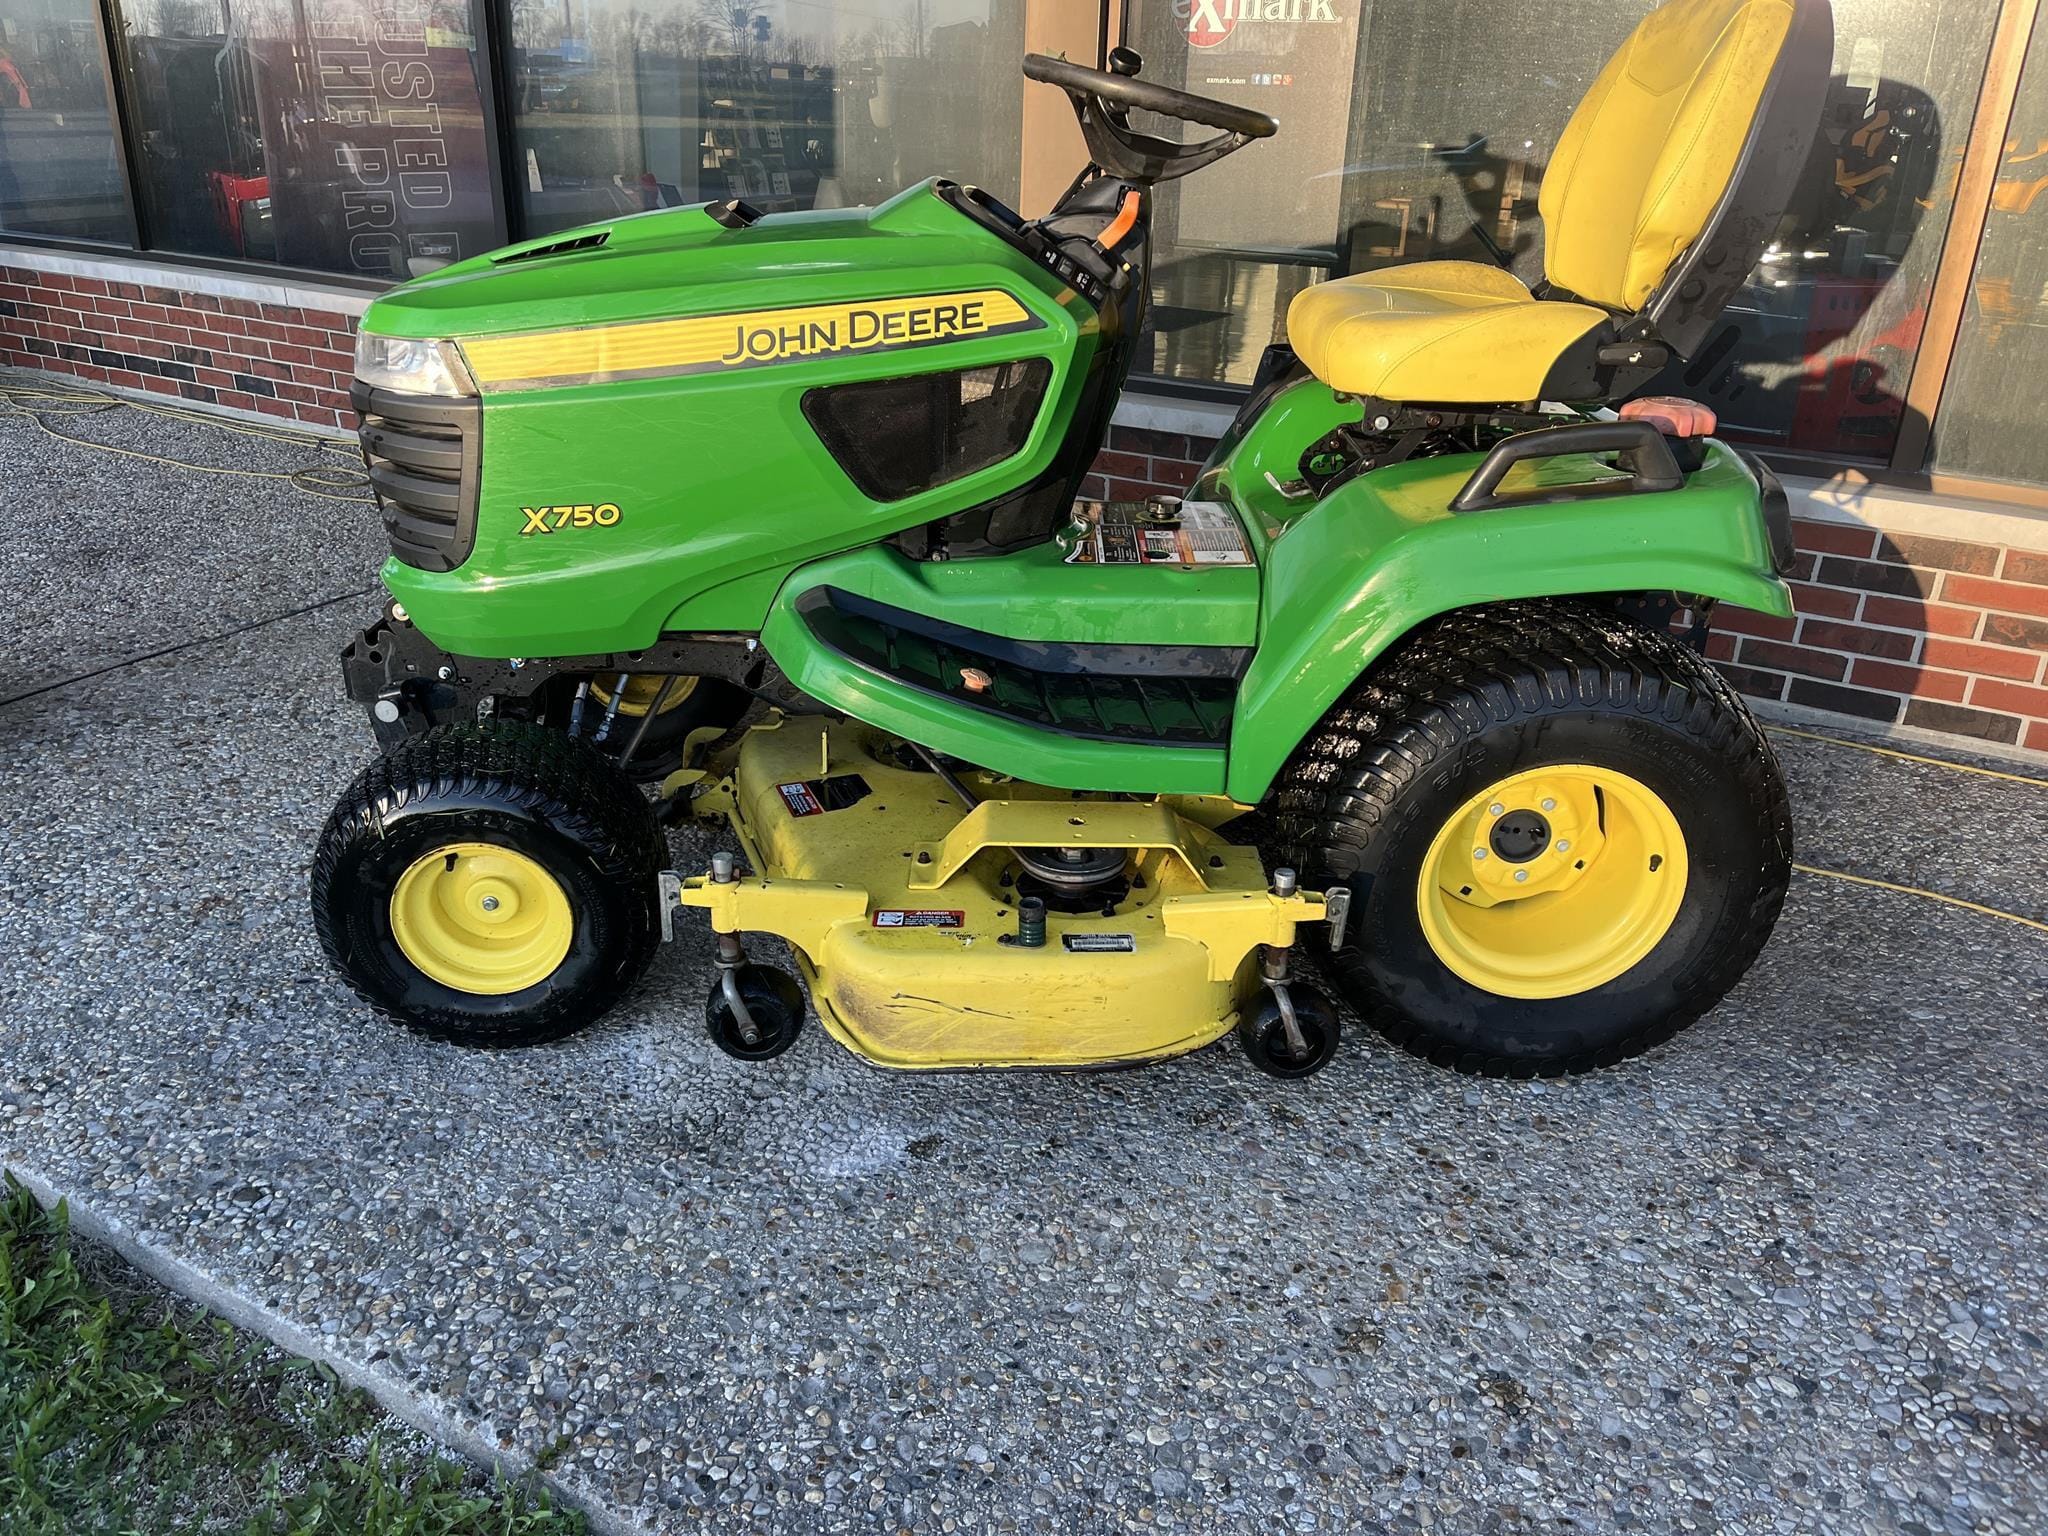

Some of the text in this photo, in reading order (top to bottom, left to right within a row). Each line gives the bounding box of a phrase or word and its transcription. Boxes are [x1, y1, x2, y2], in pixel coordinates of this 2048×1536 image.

[312, 15, 382, 124] THE
[1206, 76, 1246, 85] exmark.com
[722, 301, 985, 361] JOHN DEERE
[519, 503, 623, 535] X750
